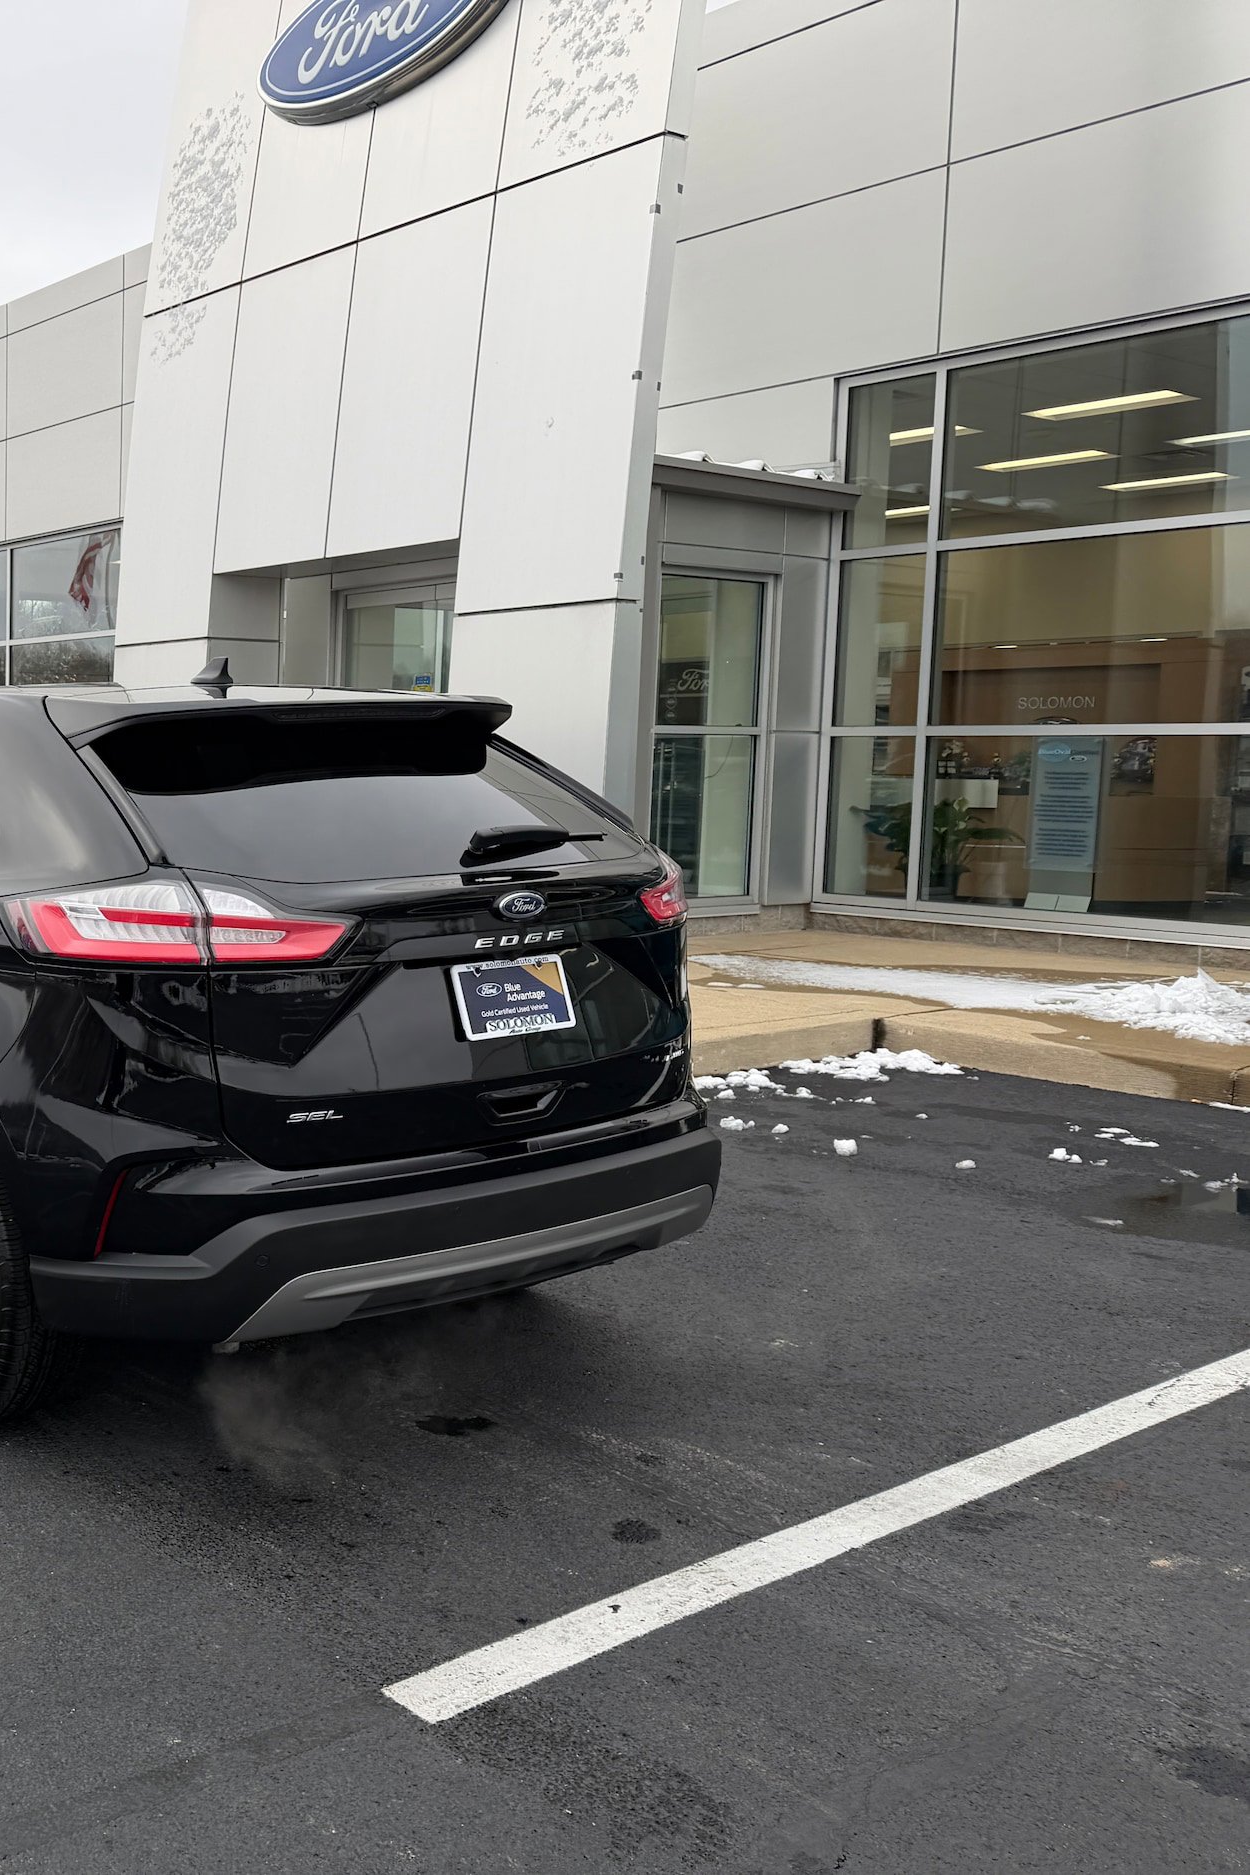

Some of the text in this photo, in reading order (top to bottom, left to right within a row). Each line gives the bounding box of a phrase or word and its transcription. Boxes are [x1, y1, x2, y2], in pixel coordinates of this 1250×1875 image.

[297, 0, 430, 84] Ford
[677, 668, 710, 691] For
[1017, 695, 1096, 710] SOLOMON
[512, 898, 536, 912] Ford
[474, 929, 565, 949] EDGE
[504, 982, 522, 993] Blue
[507, 989, 546, 1002] Advantage
[481, 1003, 549, 1018] Gold Certified Used Vehicle
[488, 1013, 555, 1032] SOLOMON
[286, 1109, 344, 1123] SEL
